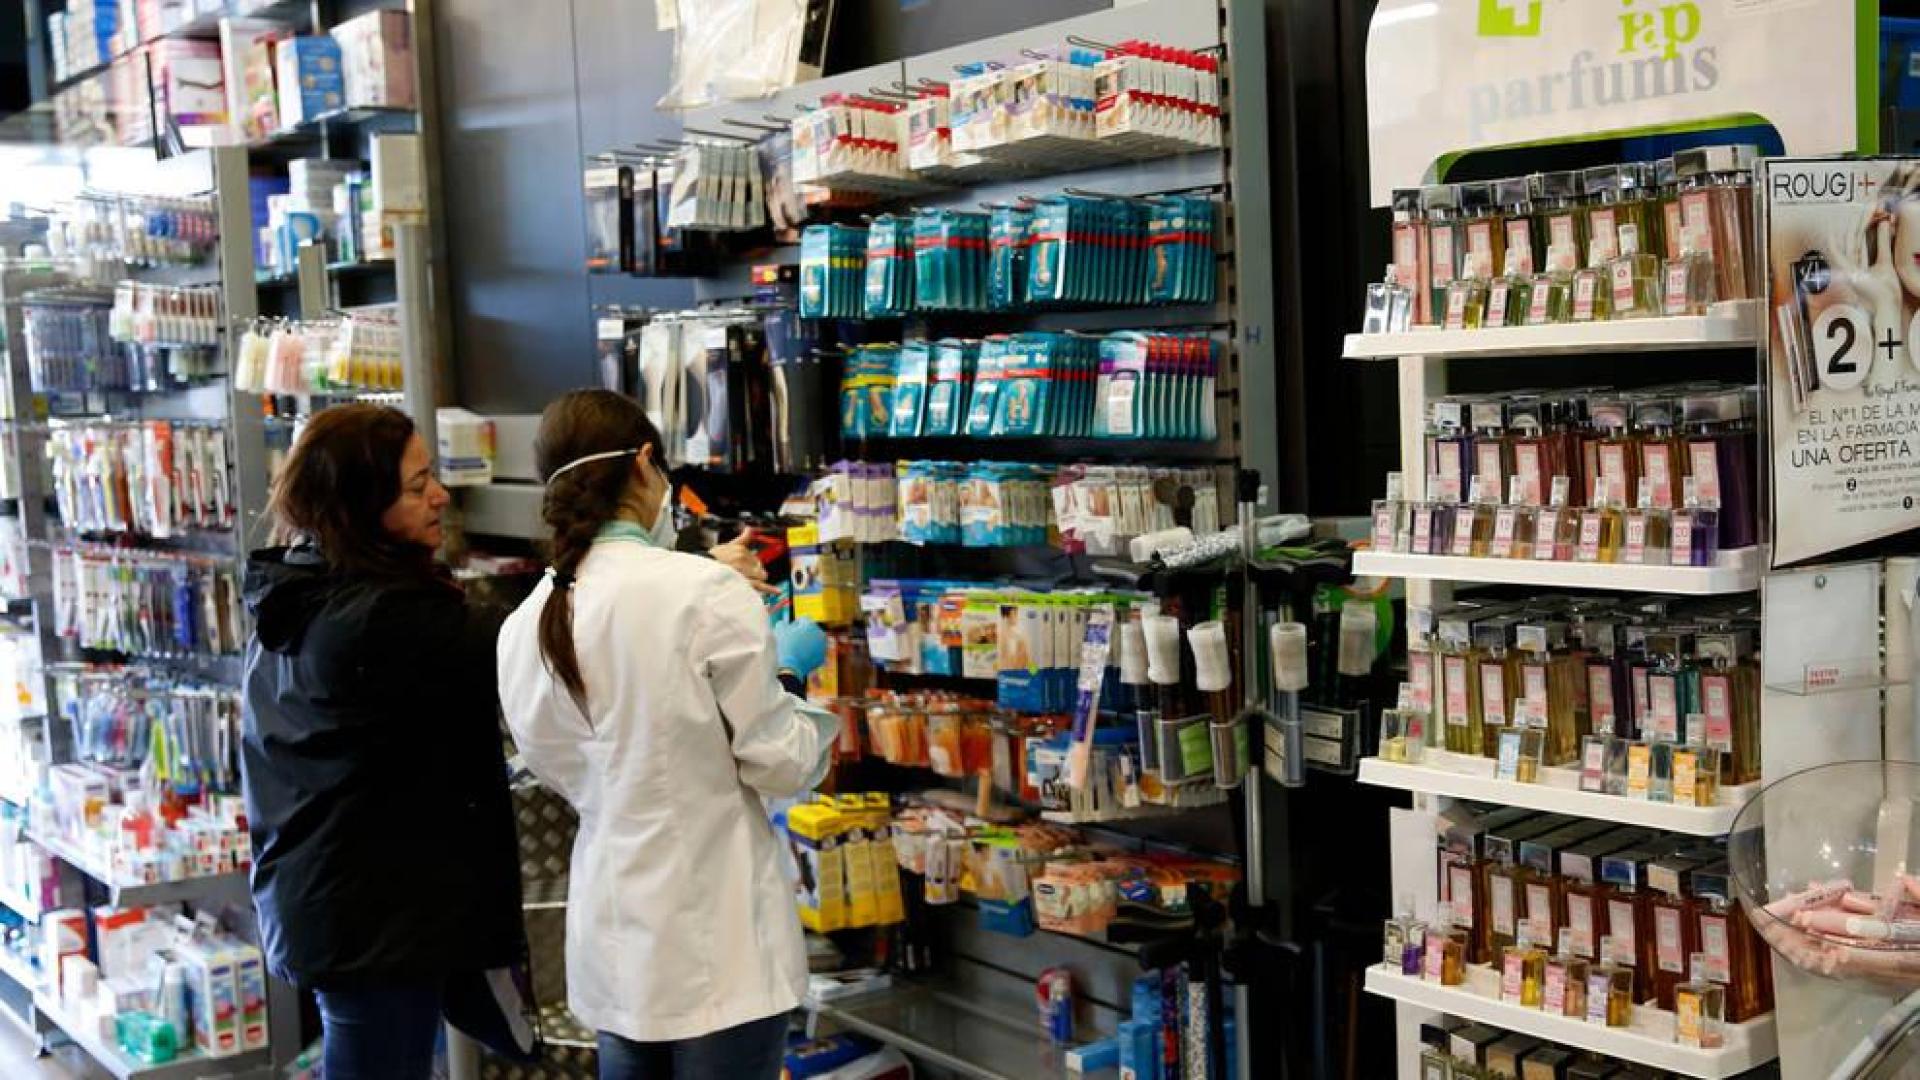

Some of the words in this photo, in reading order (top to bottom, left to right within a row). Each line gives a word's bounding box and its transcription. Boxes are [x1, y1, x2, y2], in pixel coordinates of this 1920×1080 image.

[1467, 46, 1719, 142] parfums
[1826, 317, 1857, 375] 2
[1809, 410, 1827, 426] EL
[1862, 404, 1881, 421] DE
[1886, 402, 1904, 419] LA
[1797, 429, 1818, 445] EN
[1823, 427, 1841, 442] LA
[1846, 419, 1919, 440] FARMACIA
[1791, 447, 1832, 468] UNA
[1838, 439, 1912, 464] OFERTA
